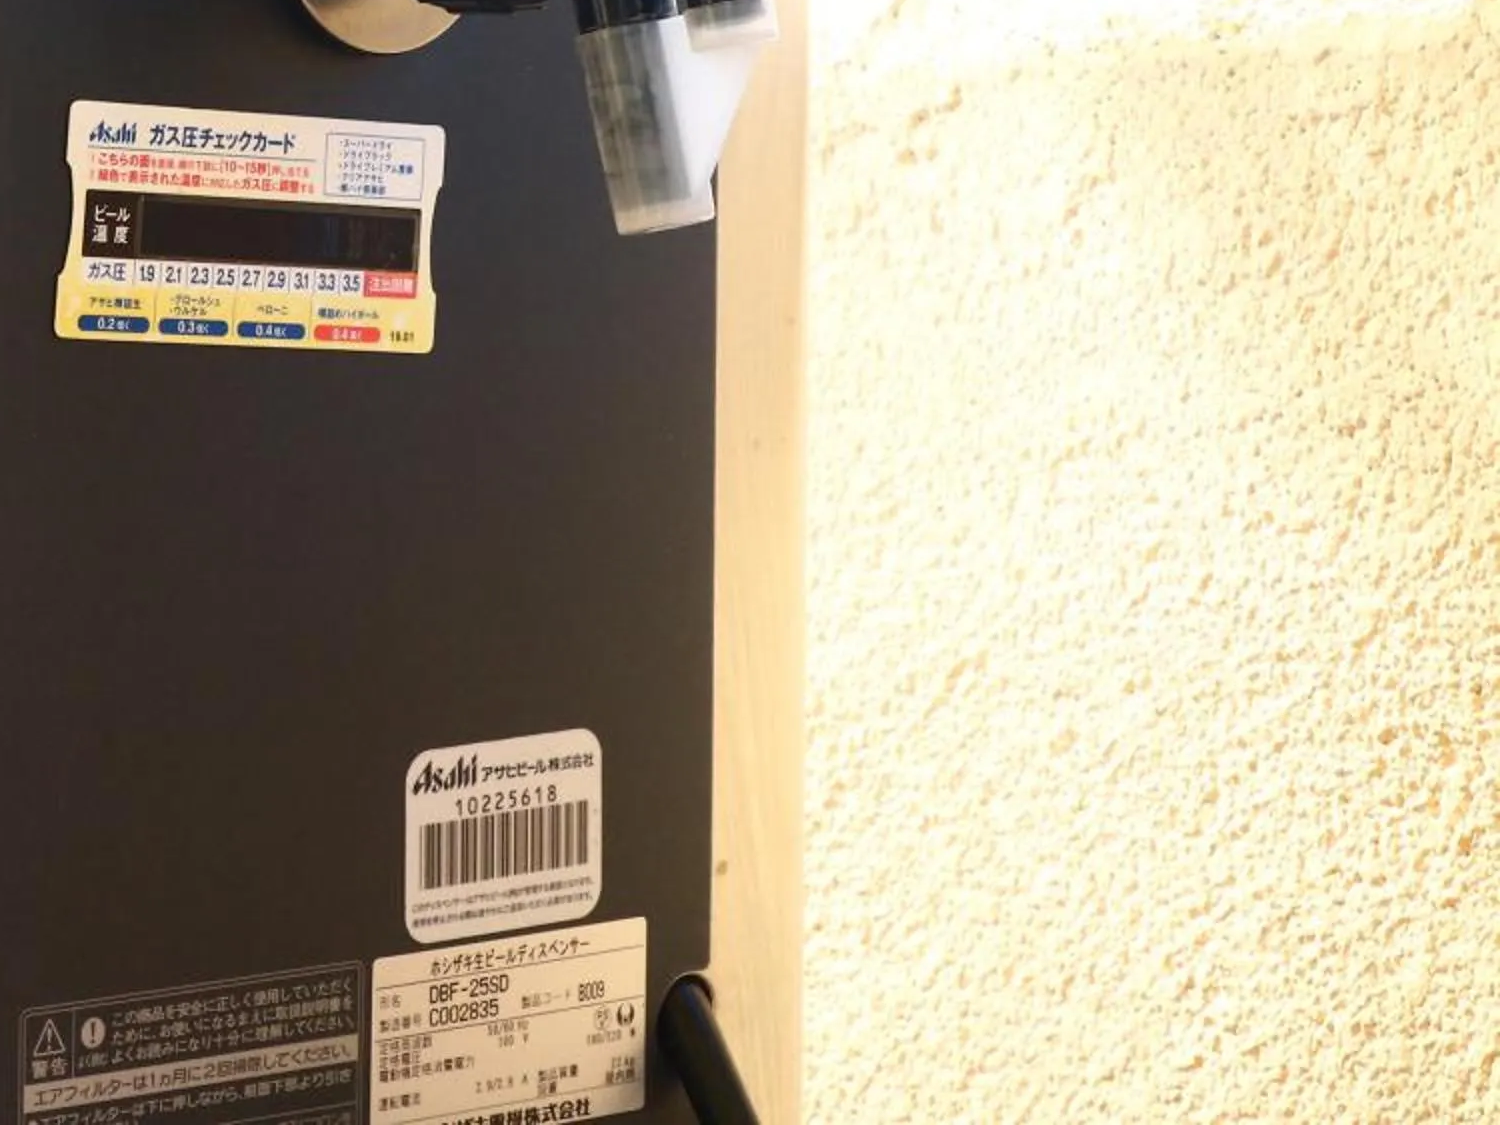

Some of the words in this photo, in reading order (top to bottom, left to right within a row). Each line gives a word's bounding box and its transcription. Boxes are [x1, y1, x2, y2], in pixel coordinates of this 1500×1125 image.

[89, 119, 136, 145] Asahi
[149, 125, 296, 155] ガス圧チェックカード
[93, 206, 130, 223] ビール
[88, 262, 126, 281] ガス圧
[140, 265, 155, 282] 1.9
[165, 266, 182, 284] 2.1
[190, 267, 209, 285] 2.3
[216, 268, 235, 286] 2.5
[242, 270, 260, 288] 2.7
[267, 271, 285, 289] 2.9
[294, 272, 309, 290] 3.1
[318, 273, 336, 291] 3.3
[343, 274, 360, 292] 3.5
[412, 754, 478, 796] Asahi
[481, 753, 595, 783] アサヒビール株式会社
[456, 785, 558, 816] 10225618
[429, 974, 509, 1004] DBF-25SD
[429, 998, 499, 1027] C002835
